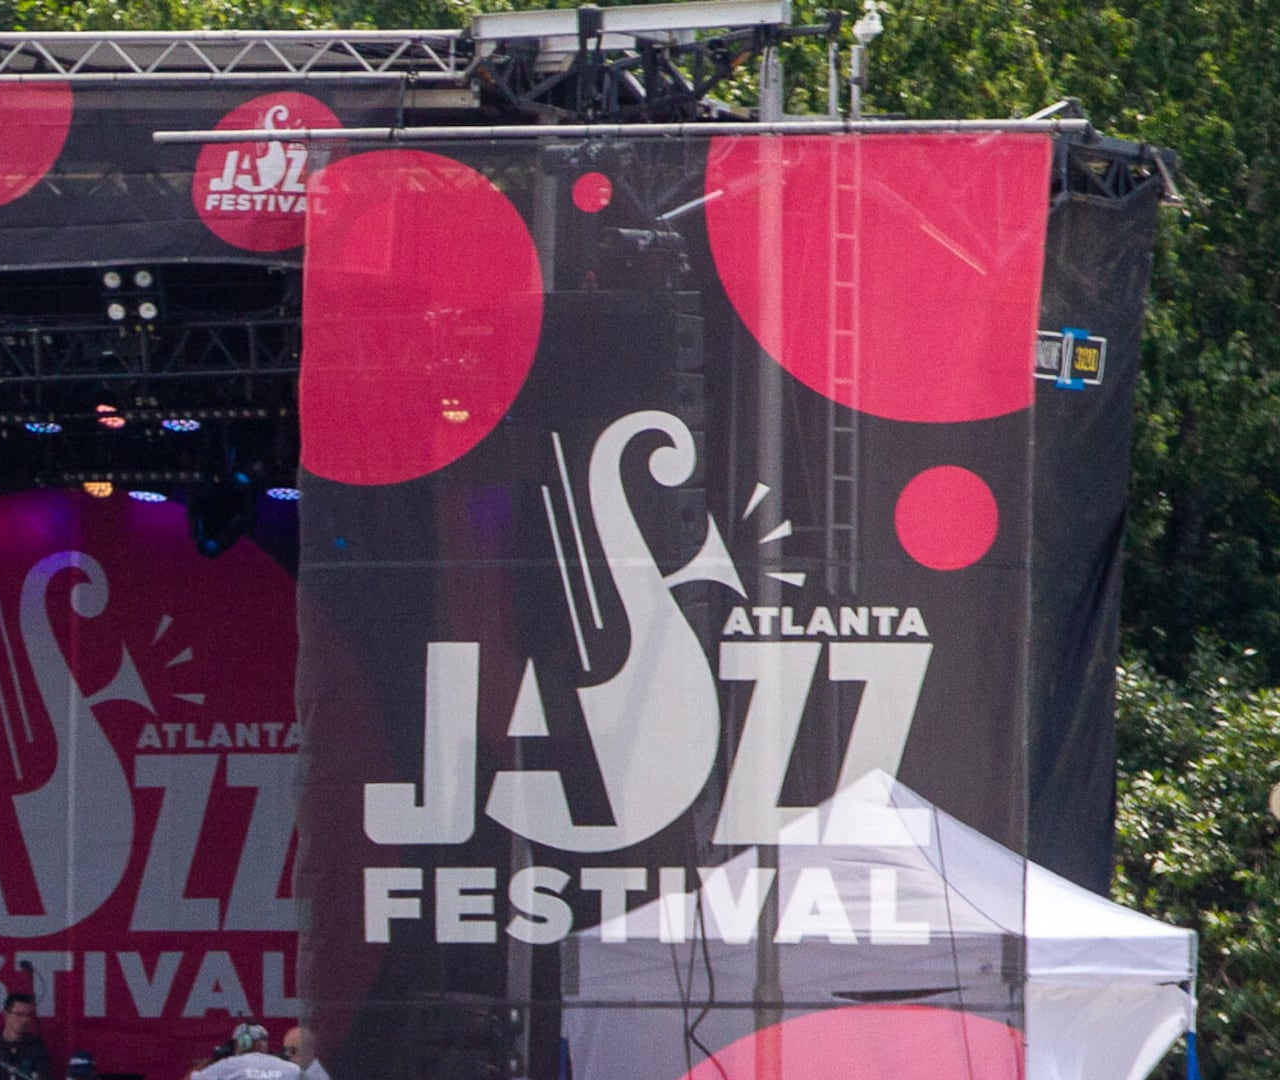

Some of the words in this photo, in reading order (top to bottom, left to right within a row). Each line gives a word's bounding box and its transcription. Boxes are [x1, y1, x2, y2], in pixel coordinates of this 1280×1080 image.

[204, 194, 328, 215] FESTIVAL
[723, 606, 928, 637] ATLANTA
[363, 540, 934, 853] JAZZ
[136, 723, 305, 749] ATLANTA
[363, 866, 931, 946] FESTIVAL
